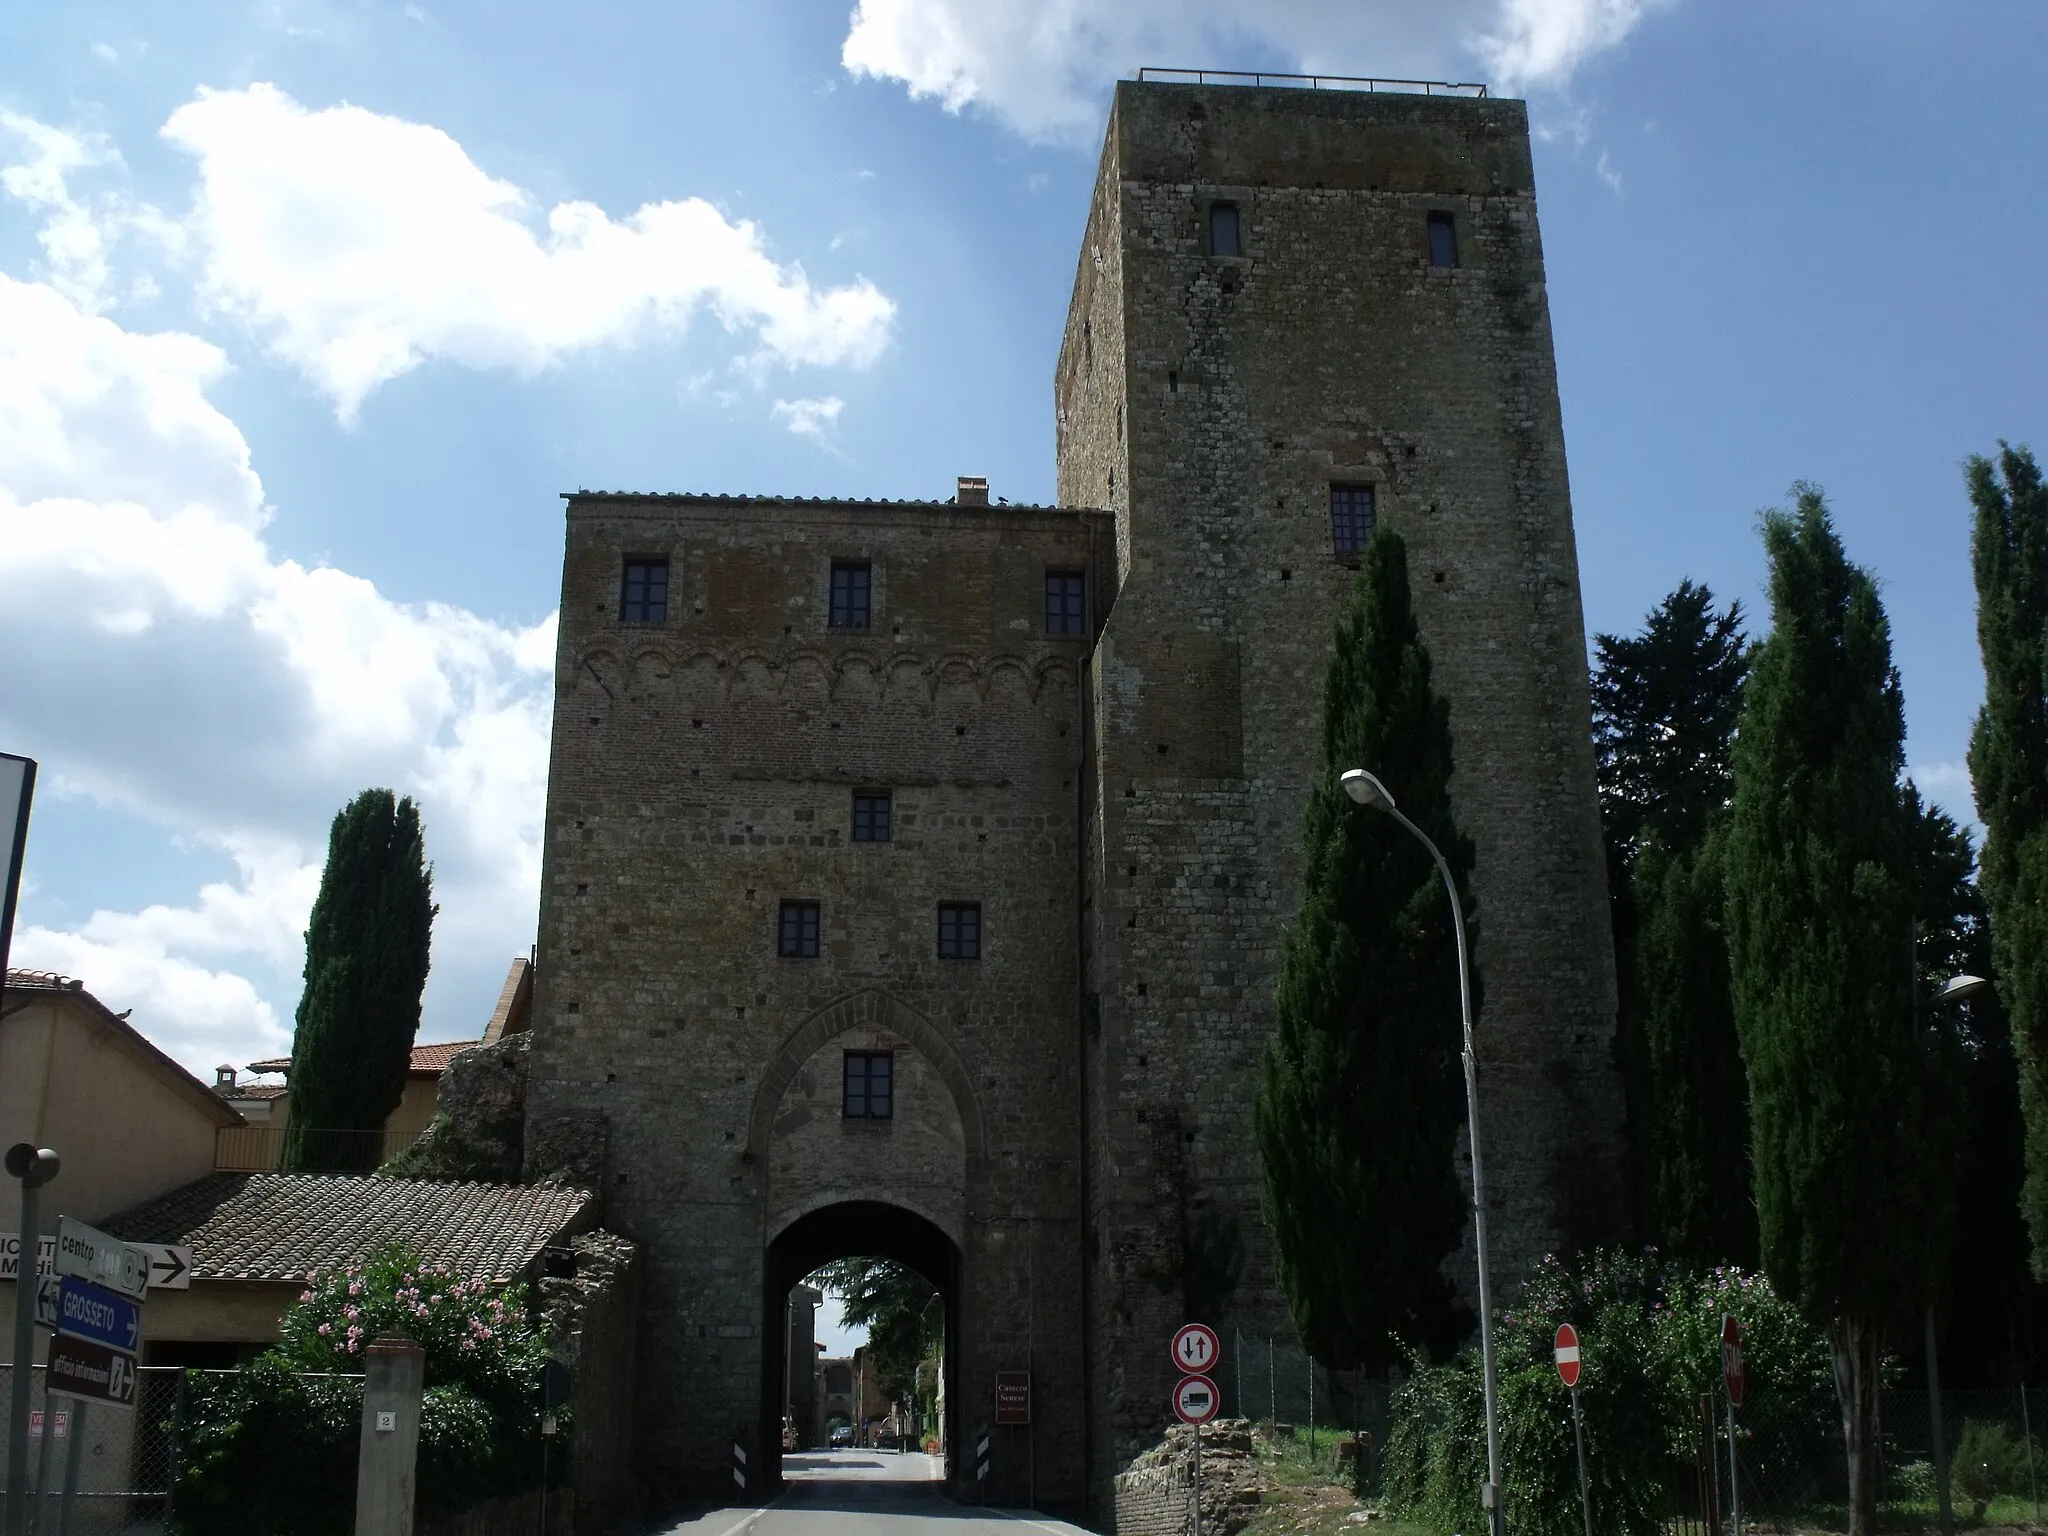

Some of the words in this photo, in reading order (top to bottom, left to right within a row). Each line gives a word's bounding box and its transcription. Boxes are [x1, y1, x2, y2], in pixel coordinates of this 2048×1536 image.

[62, 1236, 94, 1260] centro
[64, 1291, 115, 1332] GROSSETO
[54, 1355, 75, 1376] ufficio
[75, 1359, 110, 1384] informazioni
[33, 1415, 65, 1424] VEESI
[383, 1417, 390, 1425] 2
